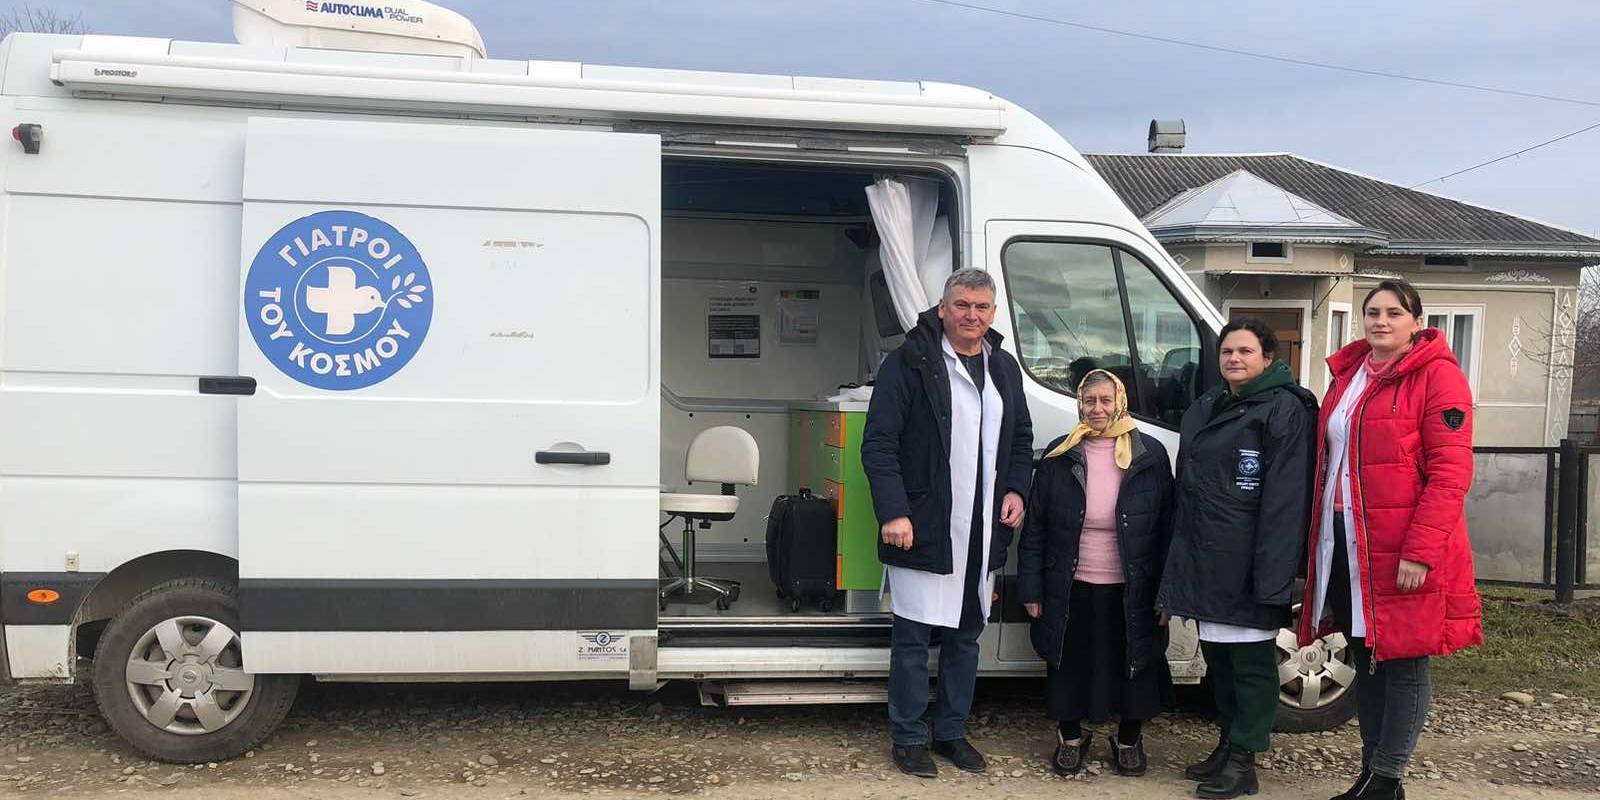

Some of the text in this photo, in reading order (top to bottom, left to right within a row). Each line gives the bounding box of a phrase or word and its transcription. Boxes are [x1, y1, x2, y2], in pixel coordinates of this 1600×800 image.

[321, 2, 384, 19] AUTOCLIMA
[384, 6, 408, 16] DUAL
[389, 14, 423, 24] POWER
[278, 225, 403, 270] ΓΙΑΤΡΟΙ
[259, 287, 411, 376] ΤΟΥ ΚΟΣΜΟΥ
